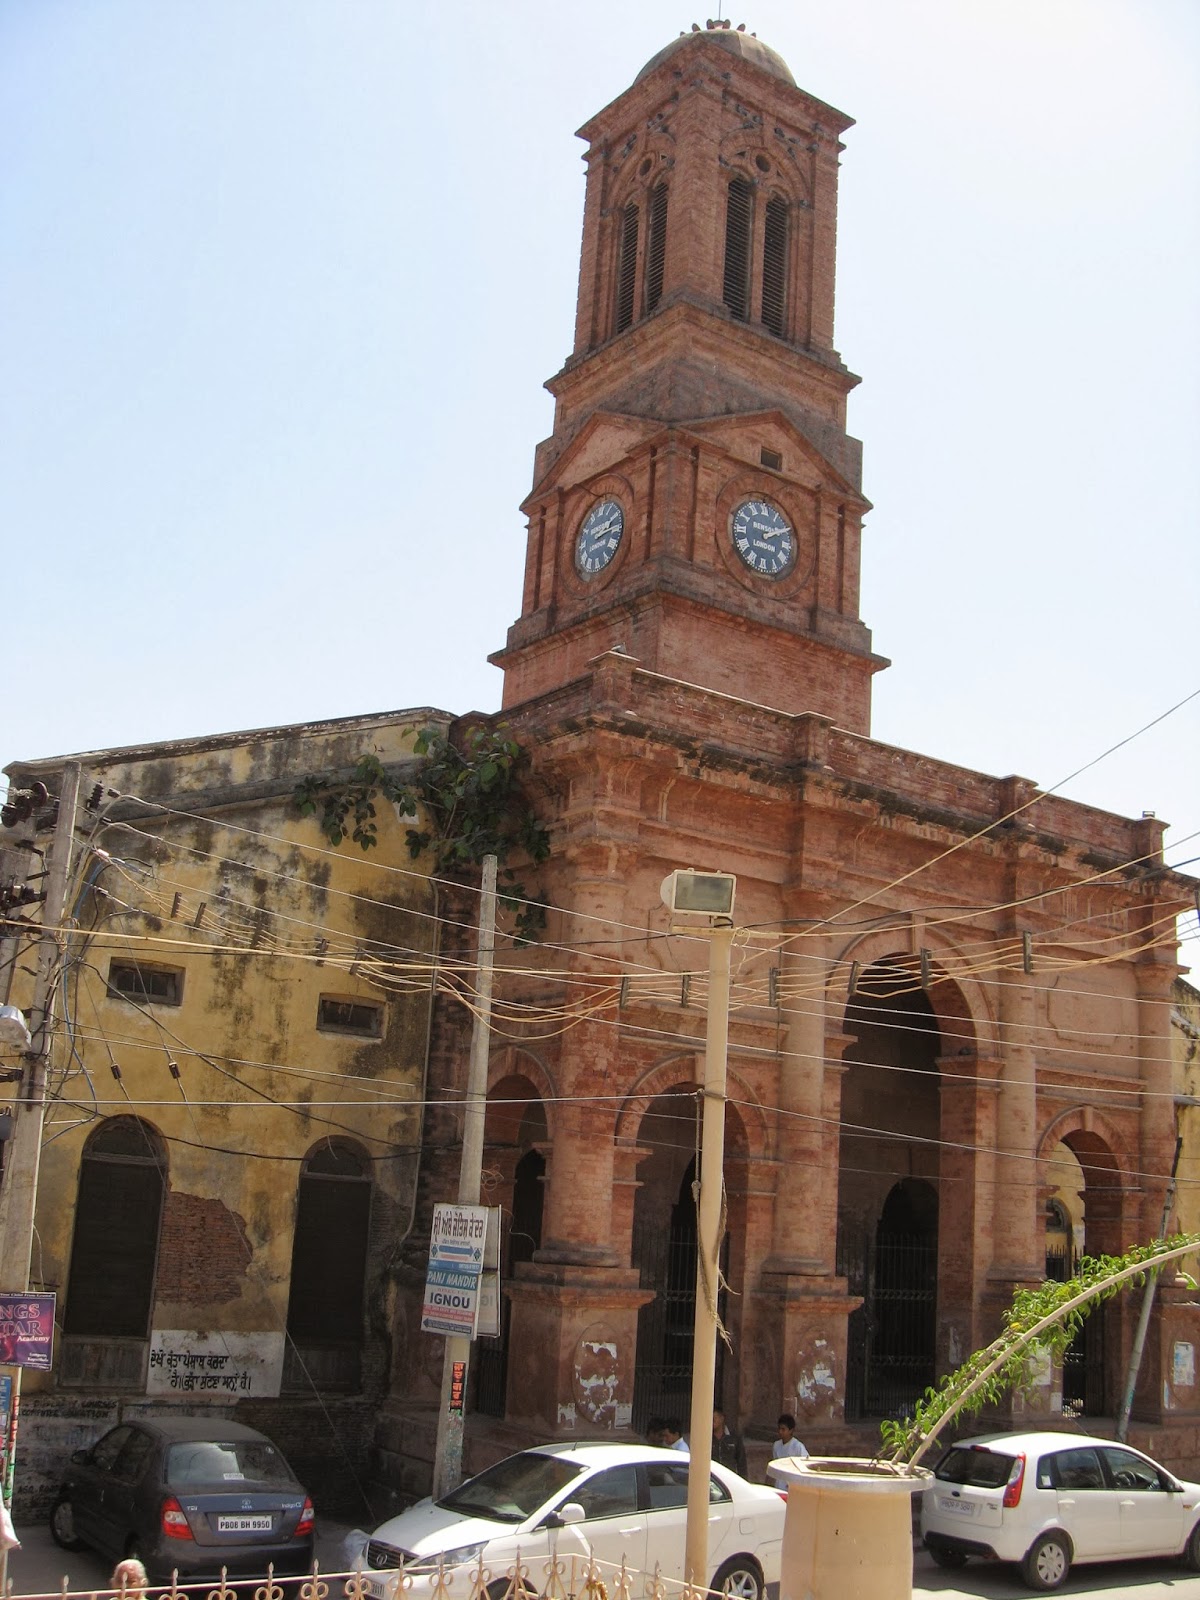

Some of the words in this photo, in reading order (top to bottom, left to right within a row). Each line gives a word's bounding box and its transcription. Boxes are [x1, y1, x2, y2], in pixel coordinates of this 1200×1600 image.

[753, 521, 776, 533] BENSO
[753, 539, 776, 553] LONDON
[426, 1271, 446, 1285] PANJ
[446, 1273, 477, 1289] MANDIR
[429, 1292, 470, 1309] IGNOU
[17, 1335, 50, 1343] Academy
[240, 1520, 251, 1529] BH
[252, 1520, 270, 1529] 9950
